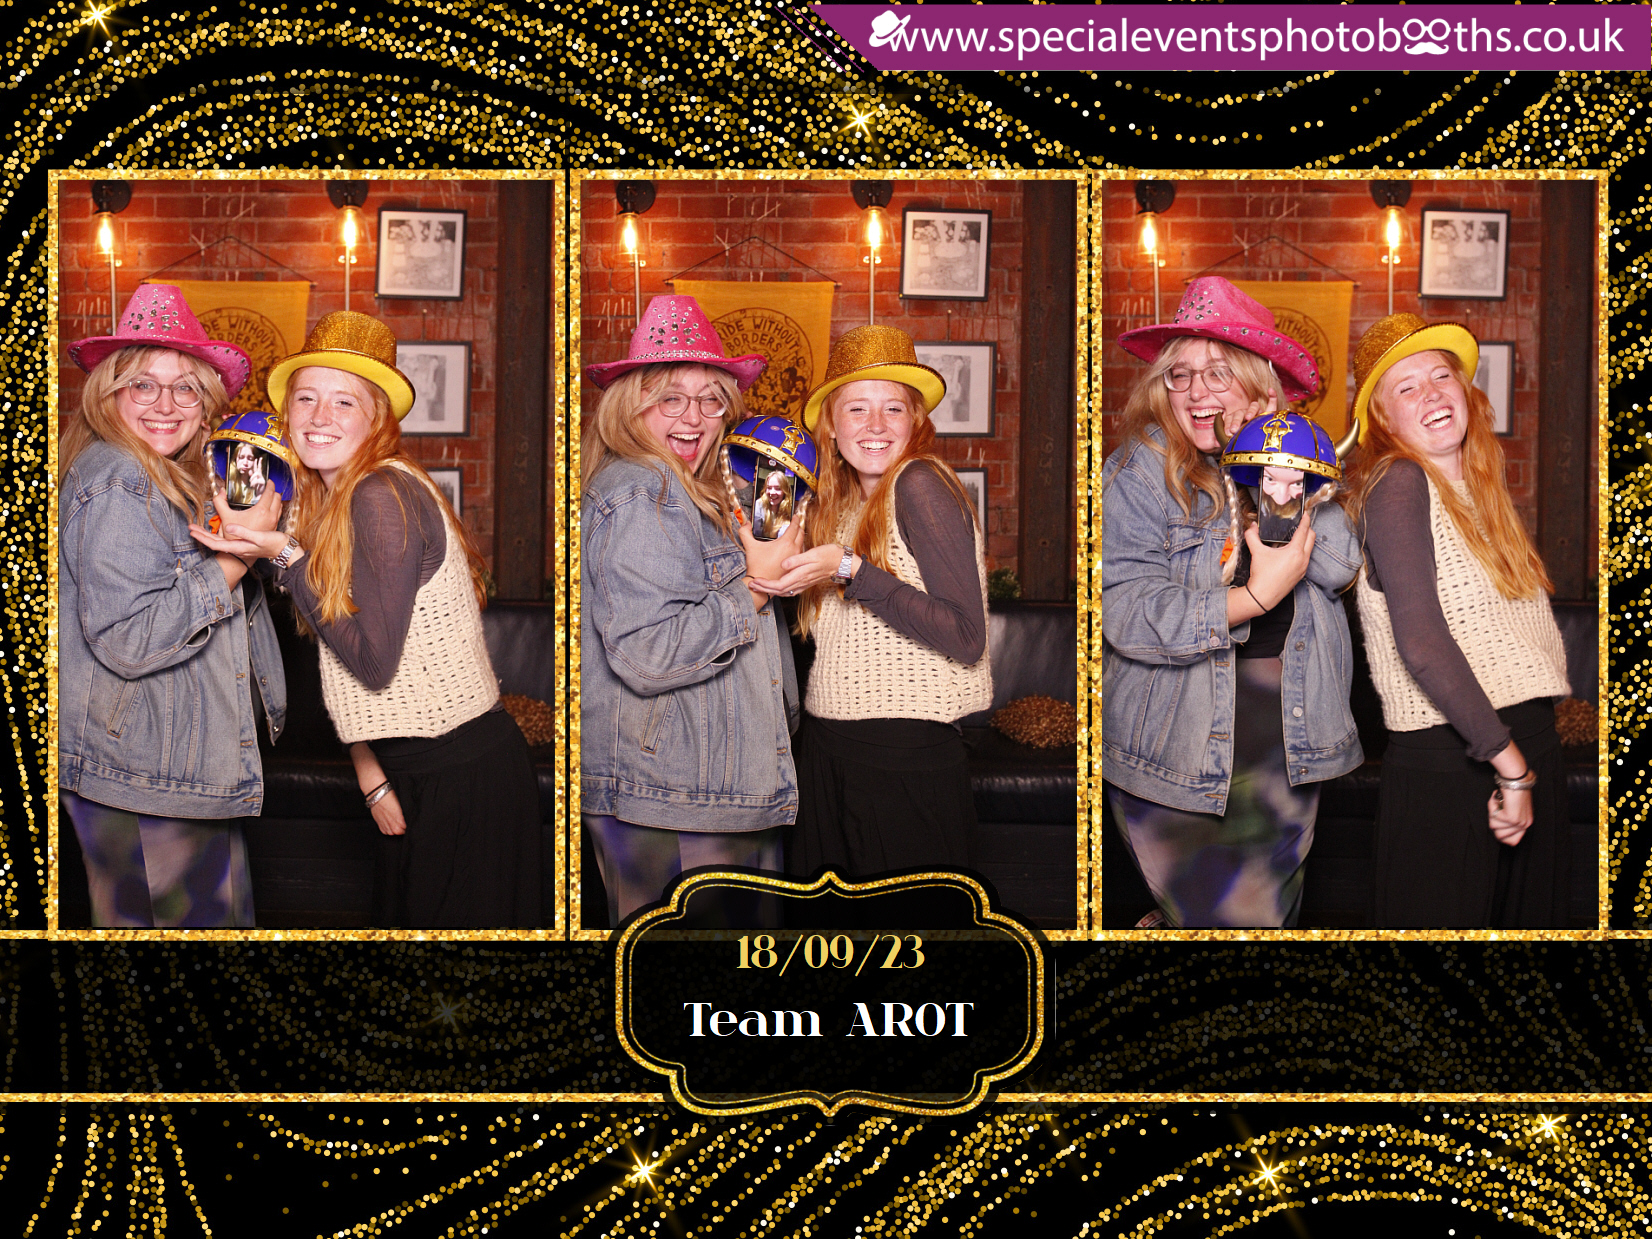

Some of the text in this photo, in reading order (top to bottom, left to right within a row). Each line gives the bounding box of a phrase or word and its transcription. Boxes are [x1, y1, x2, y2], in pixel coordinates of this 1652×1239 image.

[228, 316, 275, 350] WITHOUT
[725, 332, 782, 353] BORDERS
[752, 317, 800, 350] WITHOUT
